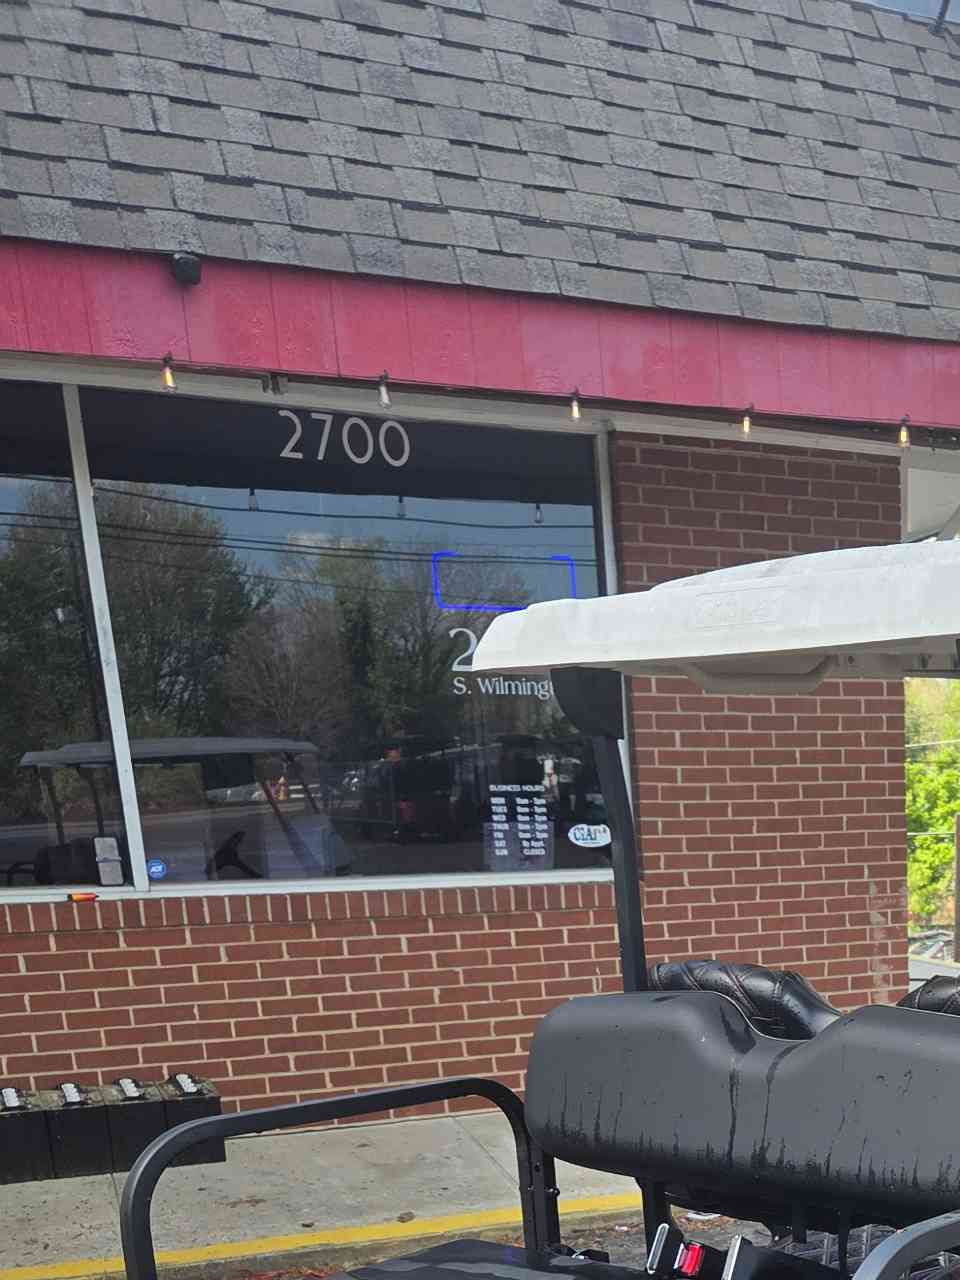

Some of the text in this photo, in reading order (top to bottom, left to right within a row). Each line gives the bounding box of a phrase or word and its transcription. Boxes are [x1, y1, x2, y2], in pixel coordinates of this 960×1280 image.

[277, 409, 411, 468] 2700
[453, 676, 472, 696] S.
[522, 784, 545, 792] HOURS
